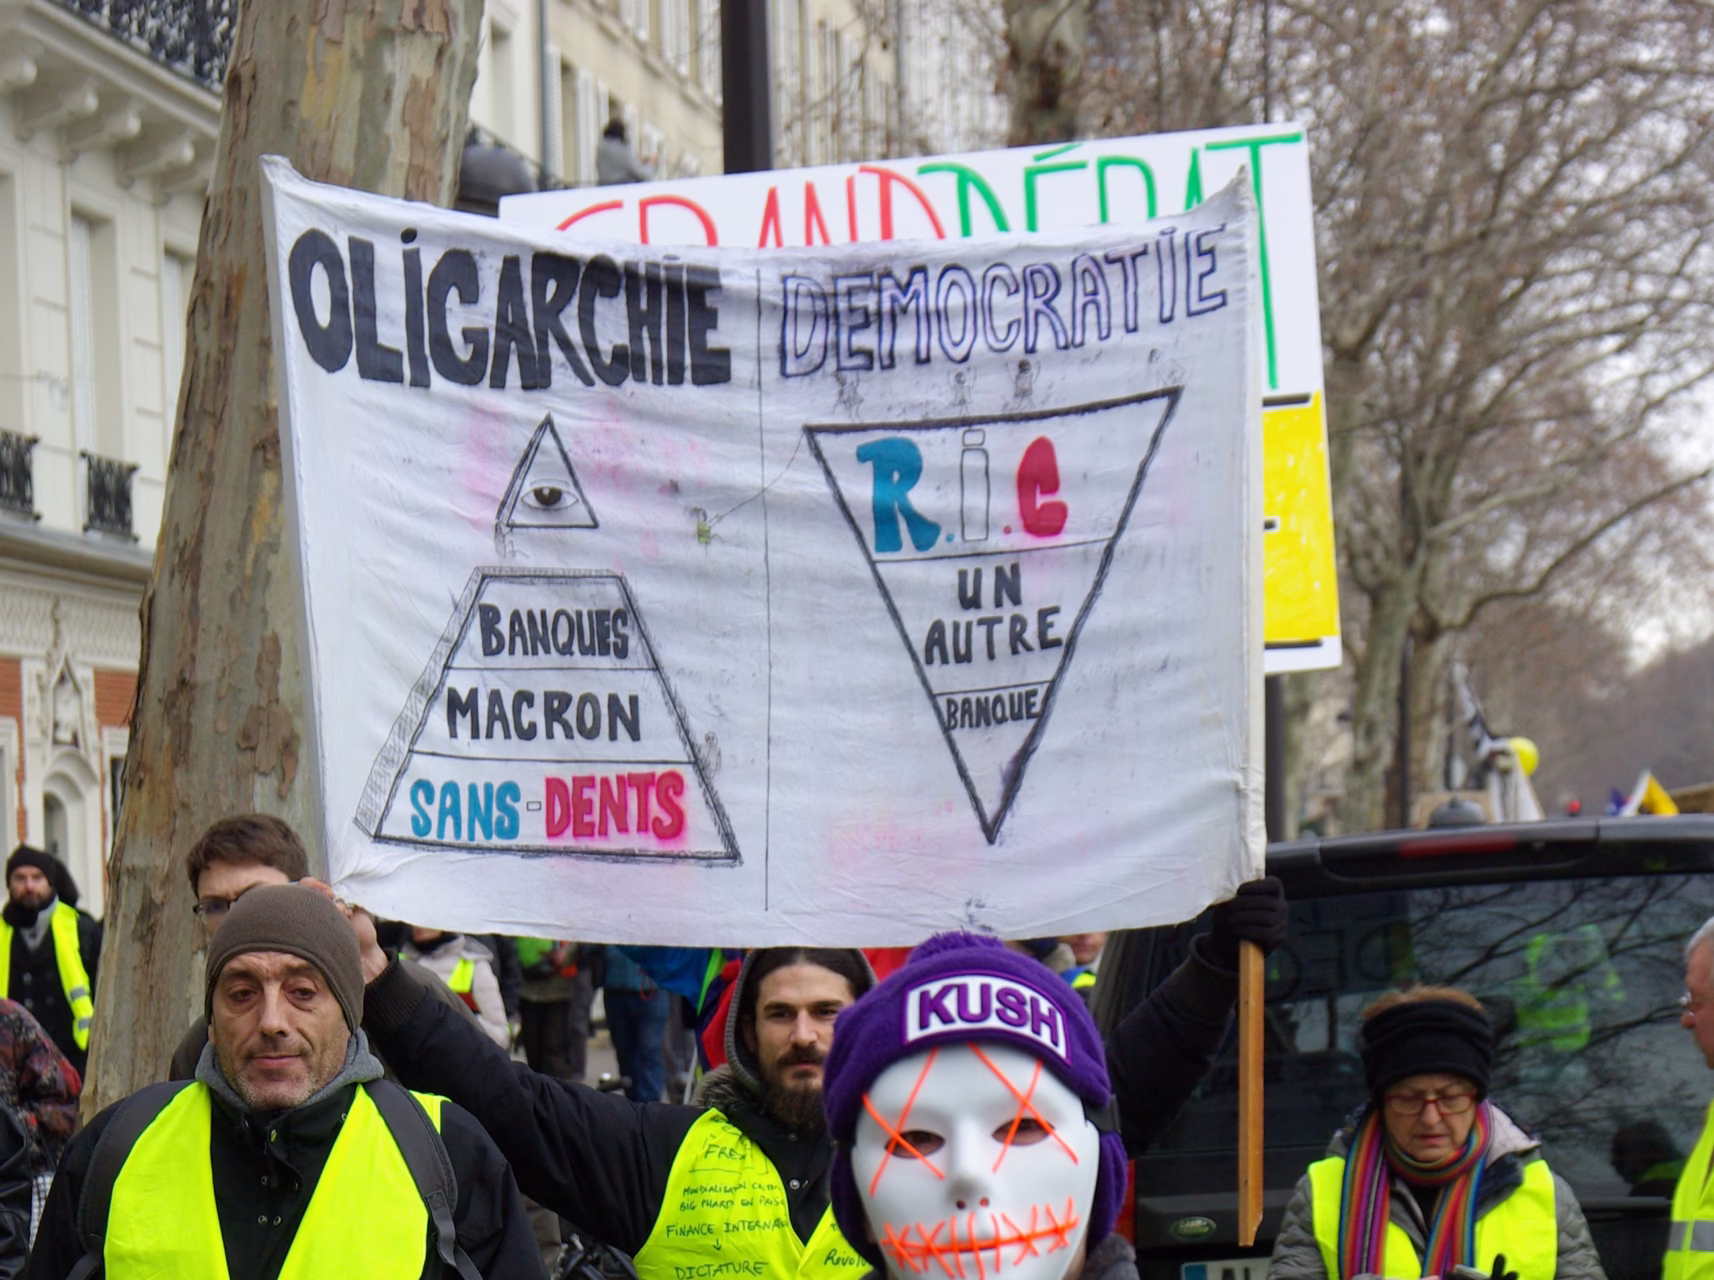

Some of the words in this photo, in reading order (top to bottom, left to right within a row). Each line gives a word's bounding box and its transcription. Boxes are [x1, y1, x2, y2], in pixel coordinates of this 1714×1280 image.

[957, 562, 1022, 610] UN
[478, 603, 630, 660] BANQUES
[924, 605, 1064, 665] AUTRE
[445, 686, 641, 742] MACRON
[945, 687, 1042, 731] BANQUE
[918, 983, 1060, 1049] KUSH
